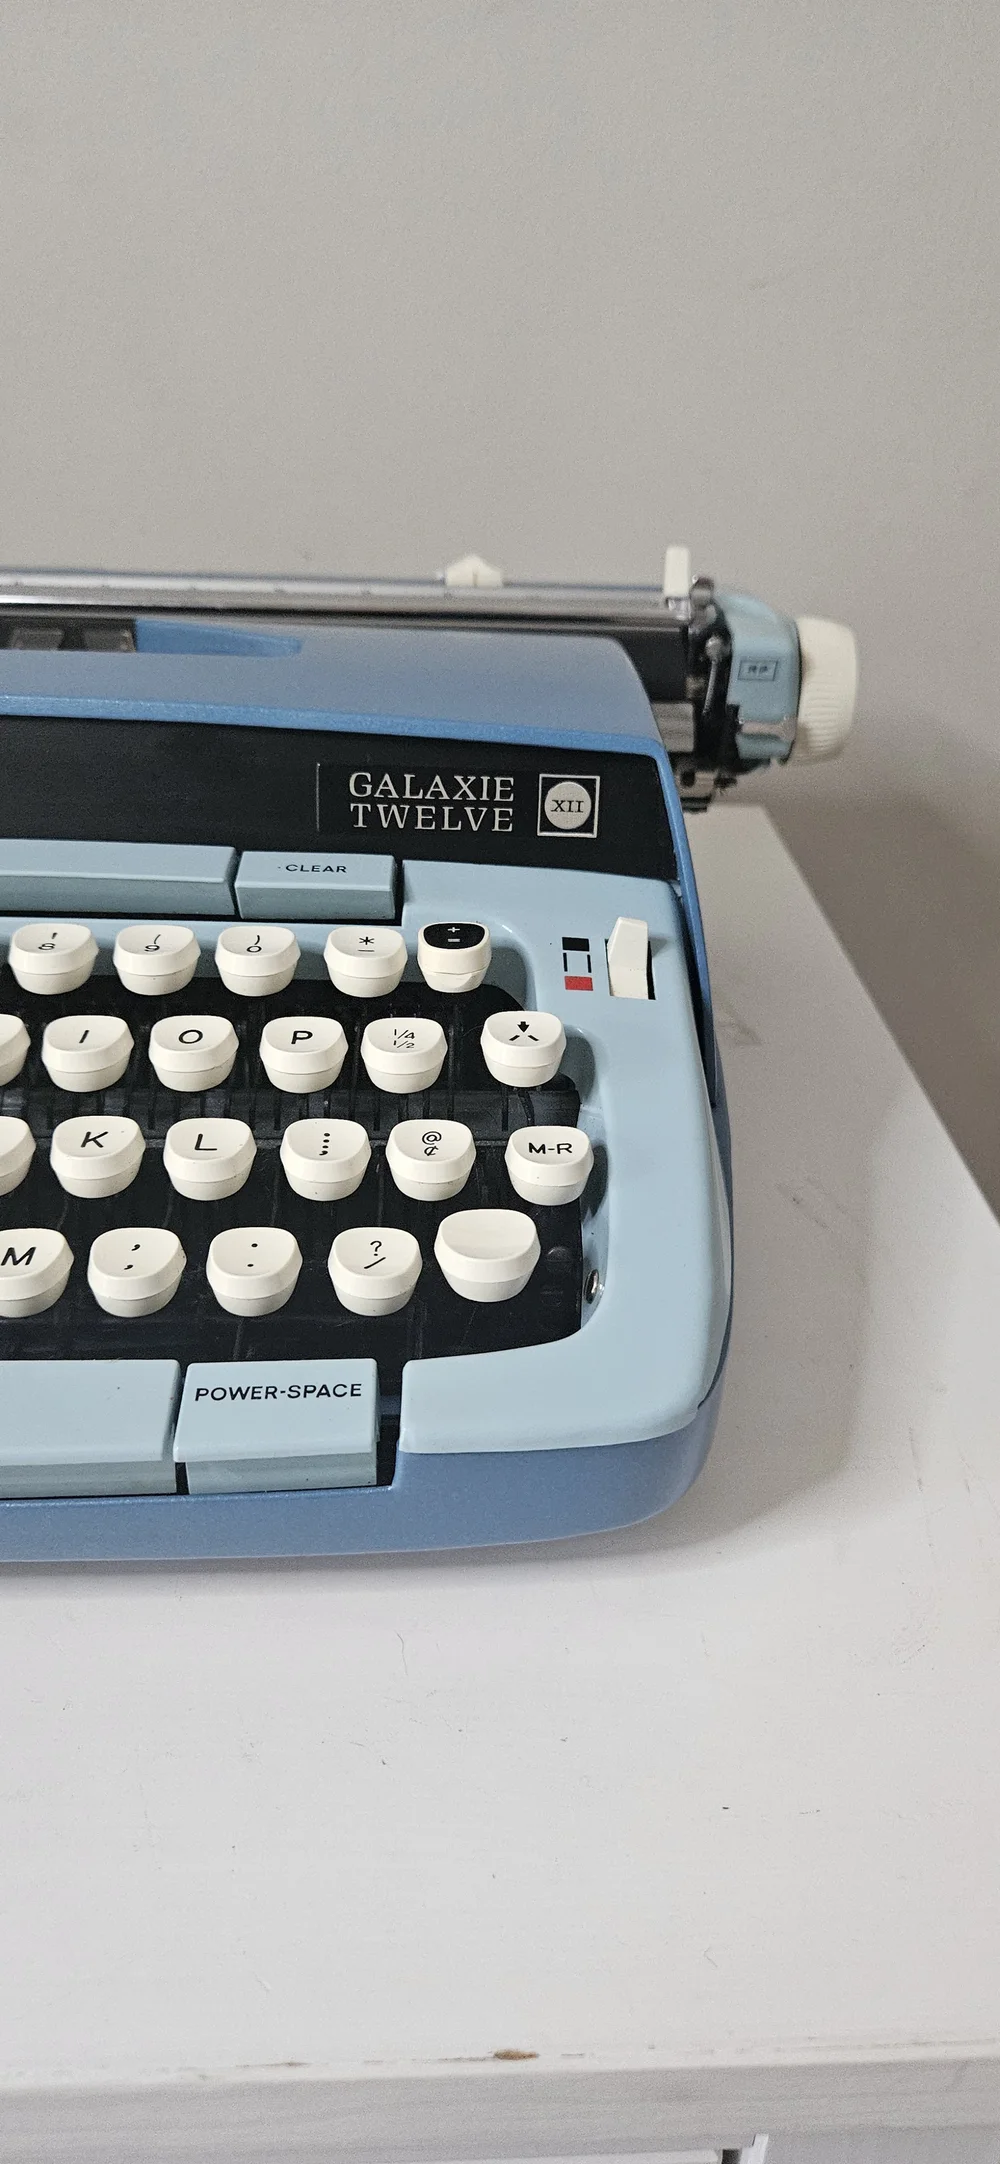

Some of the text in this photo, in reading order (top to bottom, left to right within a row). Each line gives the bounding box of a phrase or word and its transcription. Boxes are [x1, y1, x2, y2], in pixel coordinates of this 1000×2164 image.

[349, 772, 514, 802] GALAXIE
[550, 799, 584, 813] XII
[350, 803, 513, 832] TWELVE
[285, 864, 347, 873] CLEAR
[38, 942, 56, 951] 8
[79, 1030, 90, 1044] I
[178, 1029, 204, 1045] O
[291, 1030, 313, 1045] P
[80, 1131, 109, 1148] K
[194, 1133, 218, 1151] L
[421, 1131, 442, 1145] @
[424, 1145, 439, 1156] ¢
[528, 1142, 573, 1154] M-R
[370, 1240, 383, 1256] ?
[0, 1246, 37, 1266] M
[195, 1383, 362, 1401] POWER-SPACE
